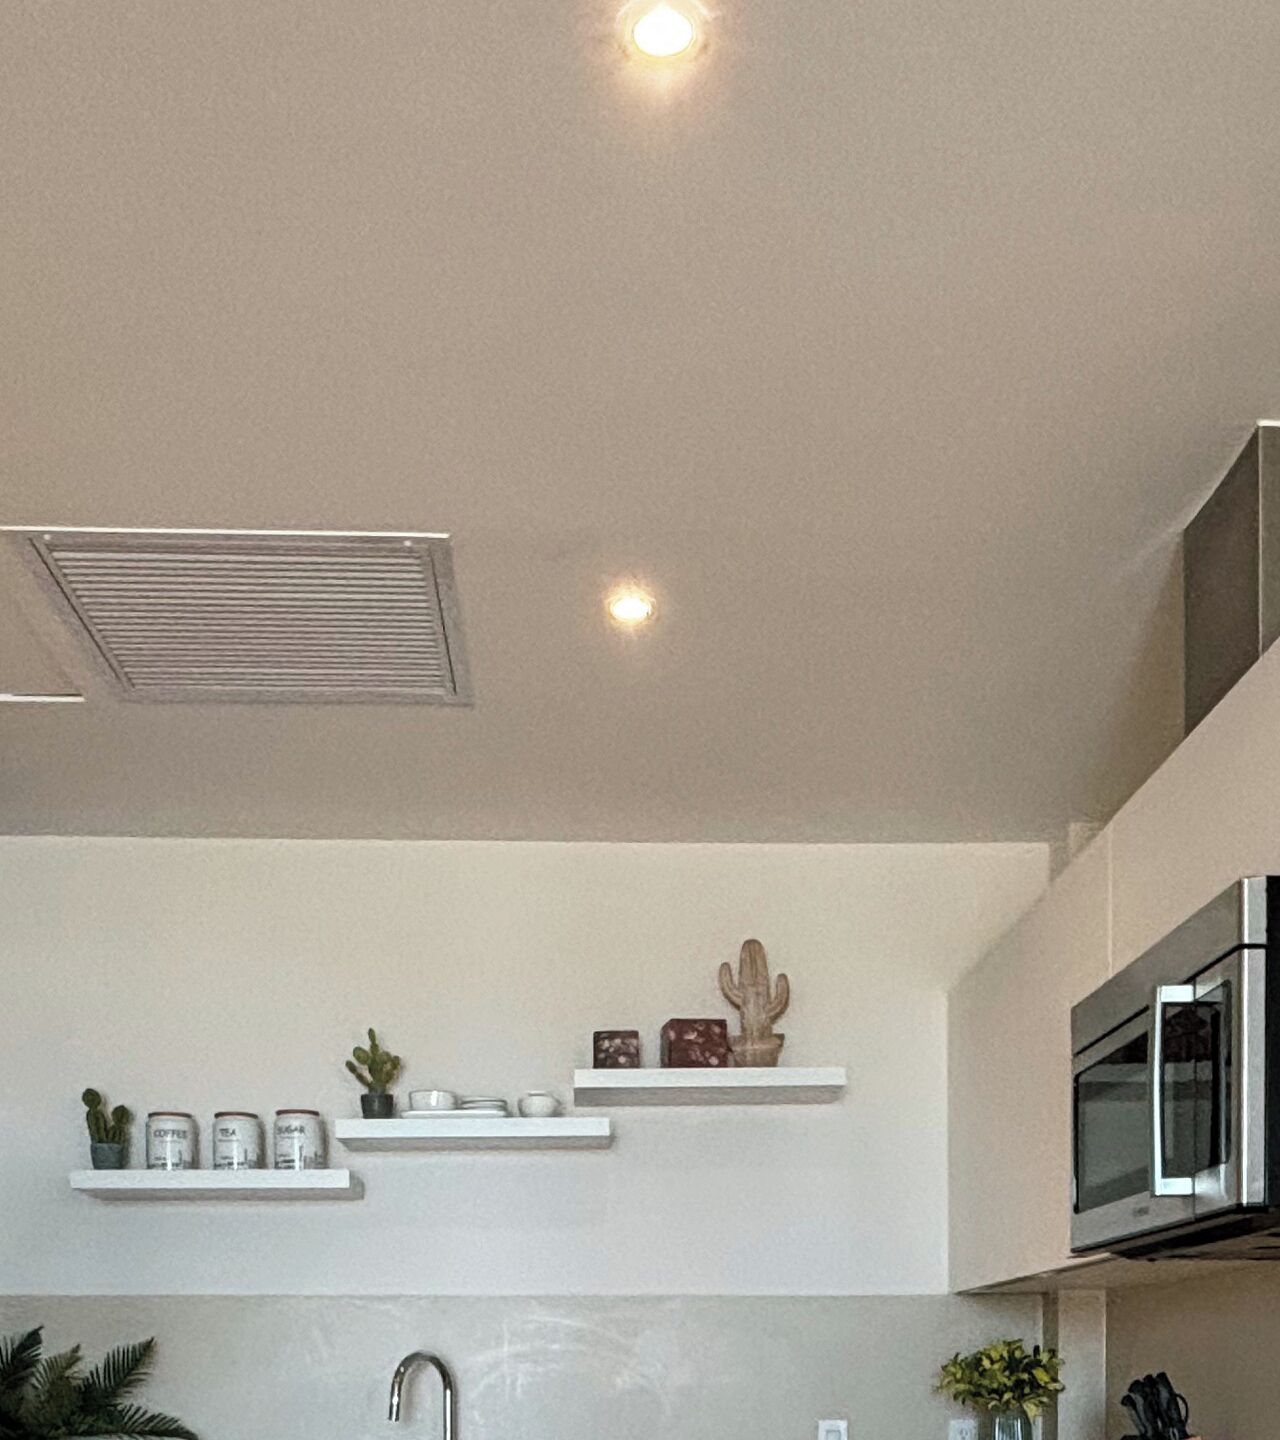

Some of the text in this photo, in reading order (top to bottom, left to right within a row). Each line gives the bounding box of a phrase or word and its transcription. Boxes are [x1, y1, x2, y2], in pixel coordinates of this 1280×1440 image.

[153, 1128, 188, 1139] COFFEE
[219, 1127, 236, 1138] TEA
[276, 1125, 306, 1136] SUGAR
